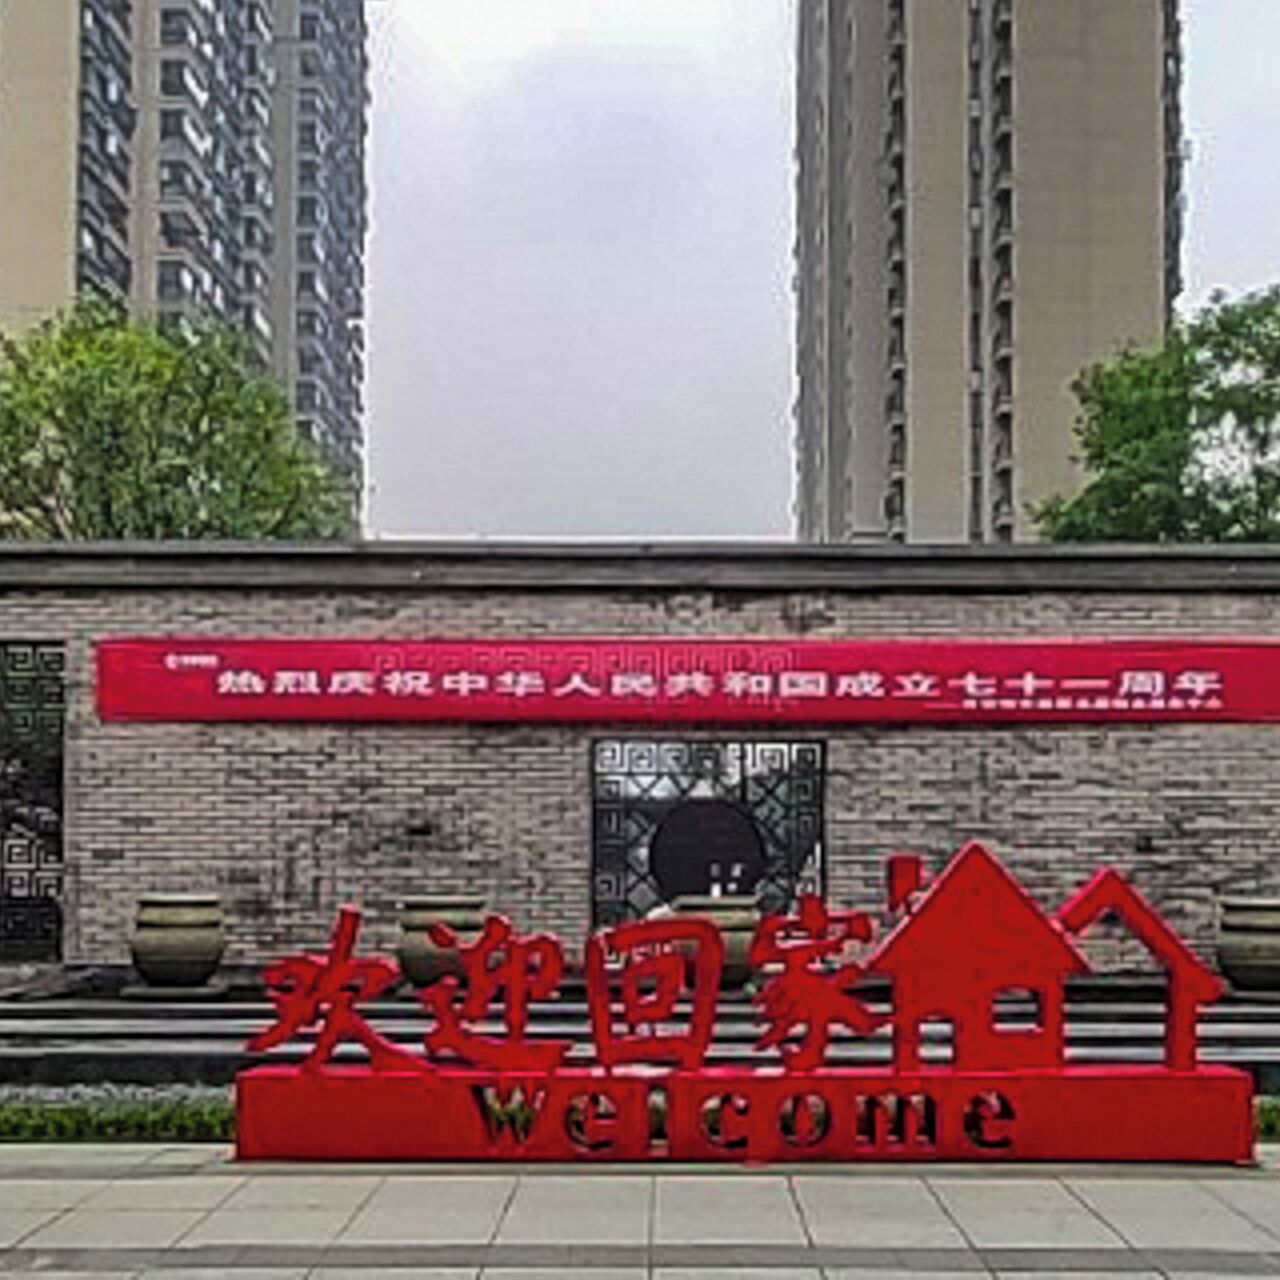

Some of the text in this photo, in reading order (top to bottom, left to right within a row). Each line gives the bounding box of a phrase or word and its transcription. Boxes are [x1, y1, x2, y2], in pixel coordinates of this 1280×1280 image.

[217, 670, 1224, 698] 热烈庆祝中华人民共和国成立七十一周年
[246, 892, 886, 1078] 欢迎回家
